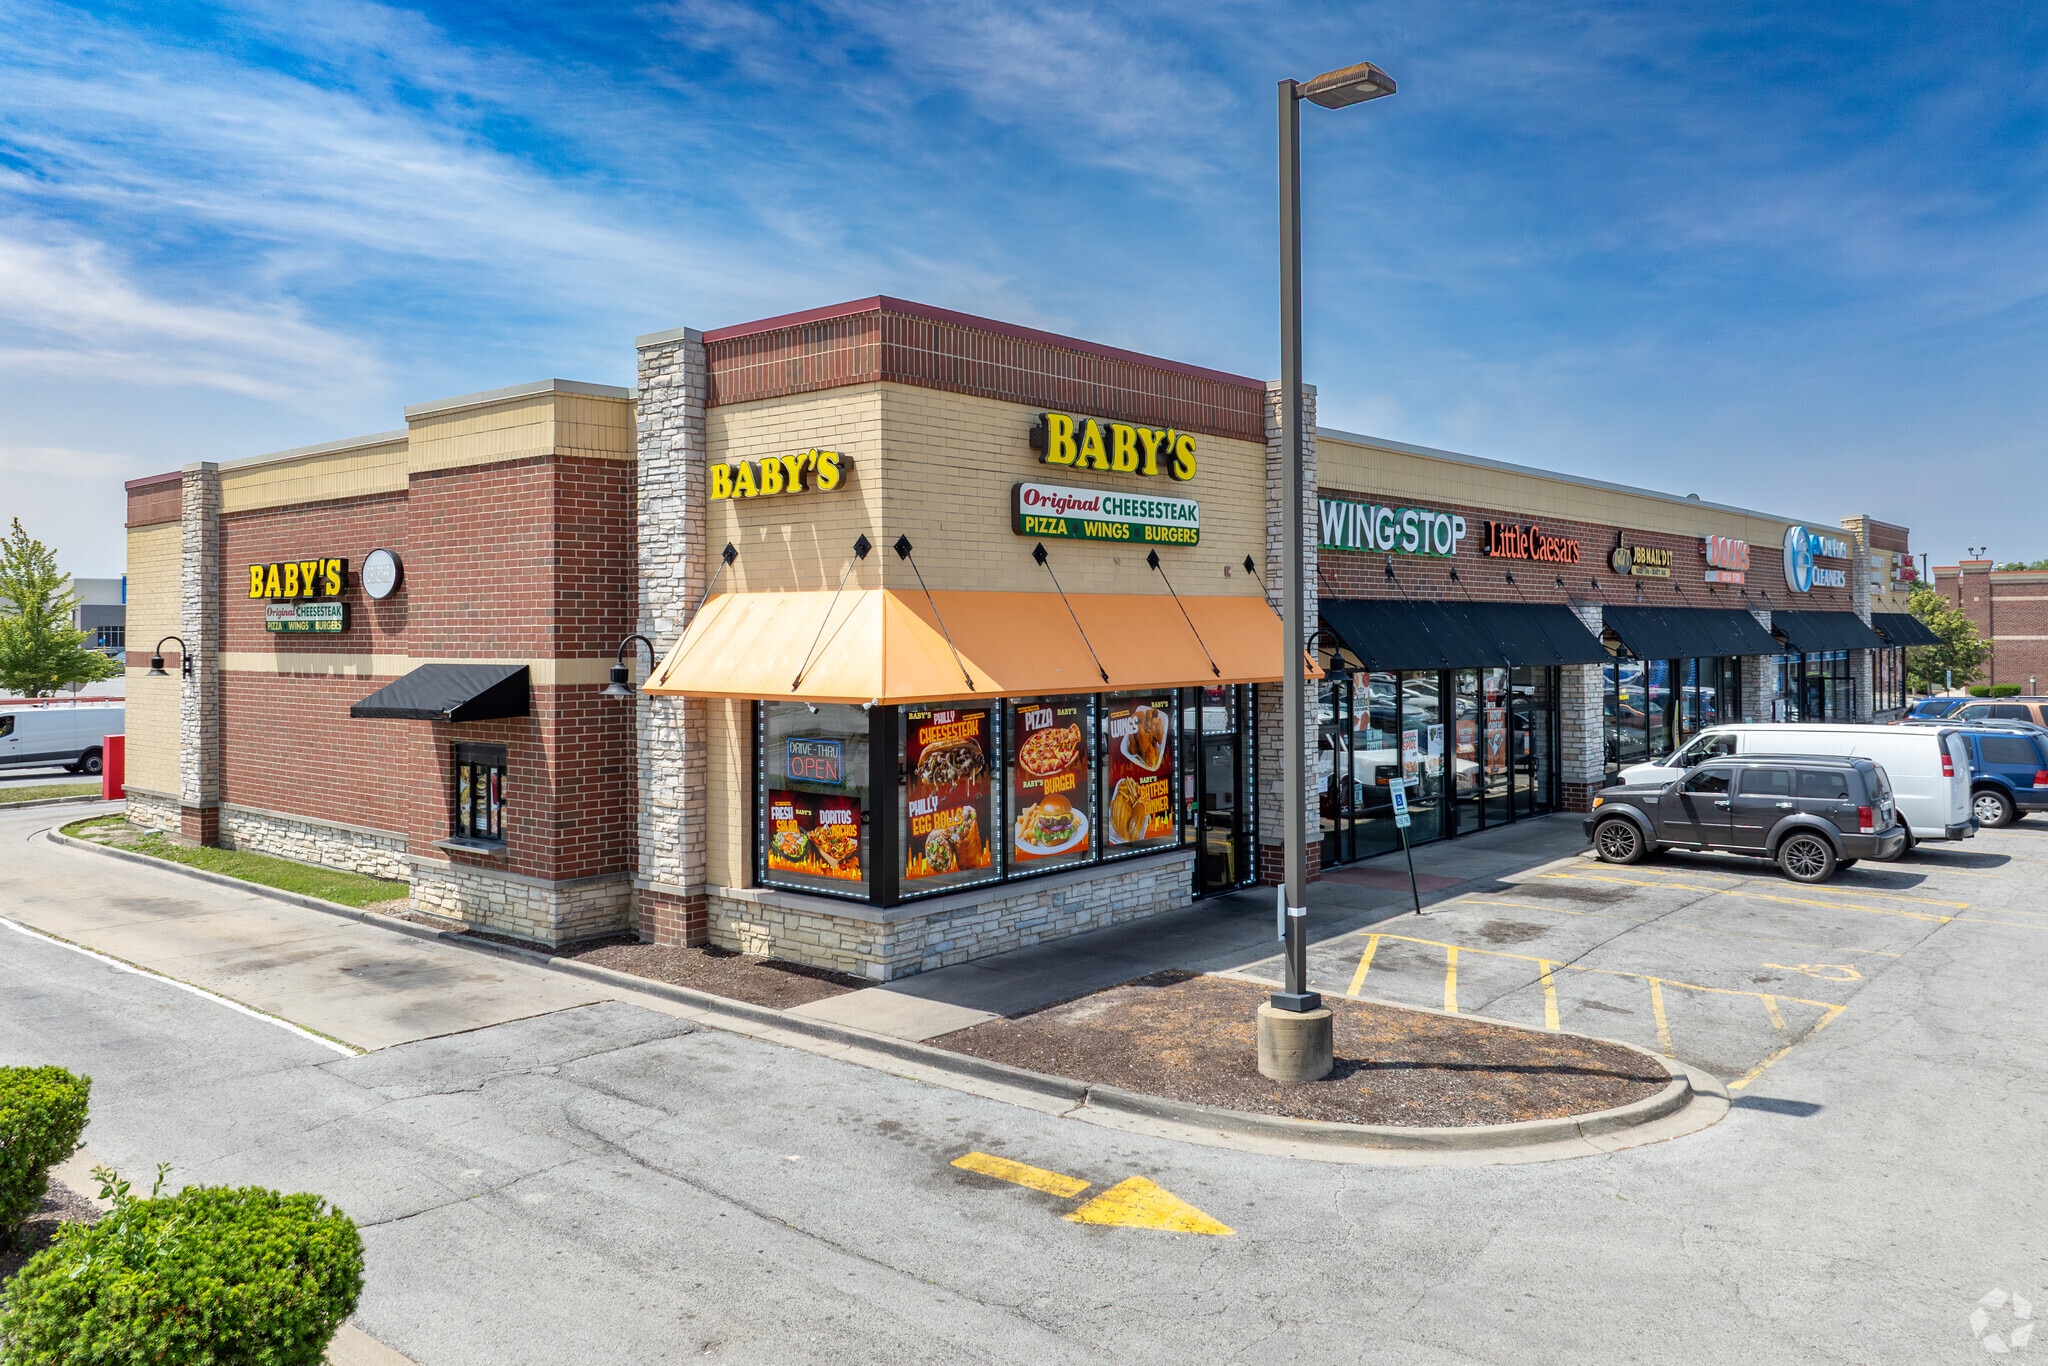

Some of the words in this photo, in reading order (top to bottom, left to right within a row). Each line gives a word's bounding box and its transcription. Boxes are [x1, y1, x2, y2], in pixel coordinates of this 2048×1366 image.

[1046, 412, 1197, 481] BABY'S
[710, 448, 840, 500] BABY'S
[1023, 488, 1100, 515] Original
[1102, 497, 1198, 522] CHEESESTEAK
[1025, 516, 1068, 535] PIZZA
[1084, 521, 1130, 539] WINGS
[1145, 525, 1198, 543] BURGERS
[1489, 521, 1528, 560] Little
[1529, 525, 1580, 564] Caesars
[249, 558, 341, 599] BABY'S
[1812, 566, 1846, 588] CLEANERS
[267, 606, 296, 620] Original
[296, 605, 342, 617] CHEESESTEAK
[267, 621, 282, 631] PIZZA
[288, 621, 309, 631] WINGS
[315, 620, 342, 631] BURGERS
[908, 712, 932, 720] BABY'S
[933, 710, 955, 725] PHILLY
[1025, 708, 1053, 731] PIZZA
[1057, 708, 1077, 716] BABY'S
[1111, 716, 1139, 738] WINGS
[920, 719, 979, 745] CHEESESTEAK
[789, 741, 838, 758] DRIVE-THRU
[791, 757, 838, 780] OPEN
[1022, 779, 1044, 788] BABY'S
[1044, 773, 1076, 795] BURGER
[1141, 779, 1168, 800] CATFISH
[771, 806, 793, 819] FRESH
[819, 810, 852, 825] DORITOS
[908, 796, 938, 818] PHILLY
[1144, 796, 1169, 815] DINNER
[776, 820, 798, 832] SALAD
[831, 824, 857, 837] NACHOS
[912, 815, 932, 836] EGG
[933, 807, 963, 830] ROLLS
